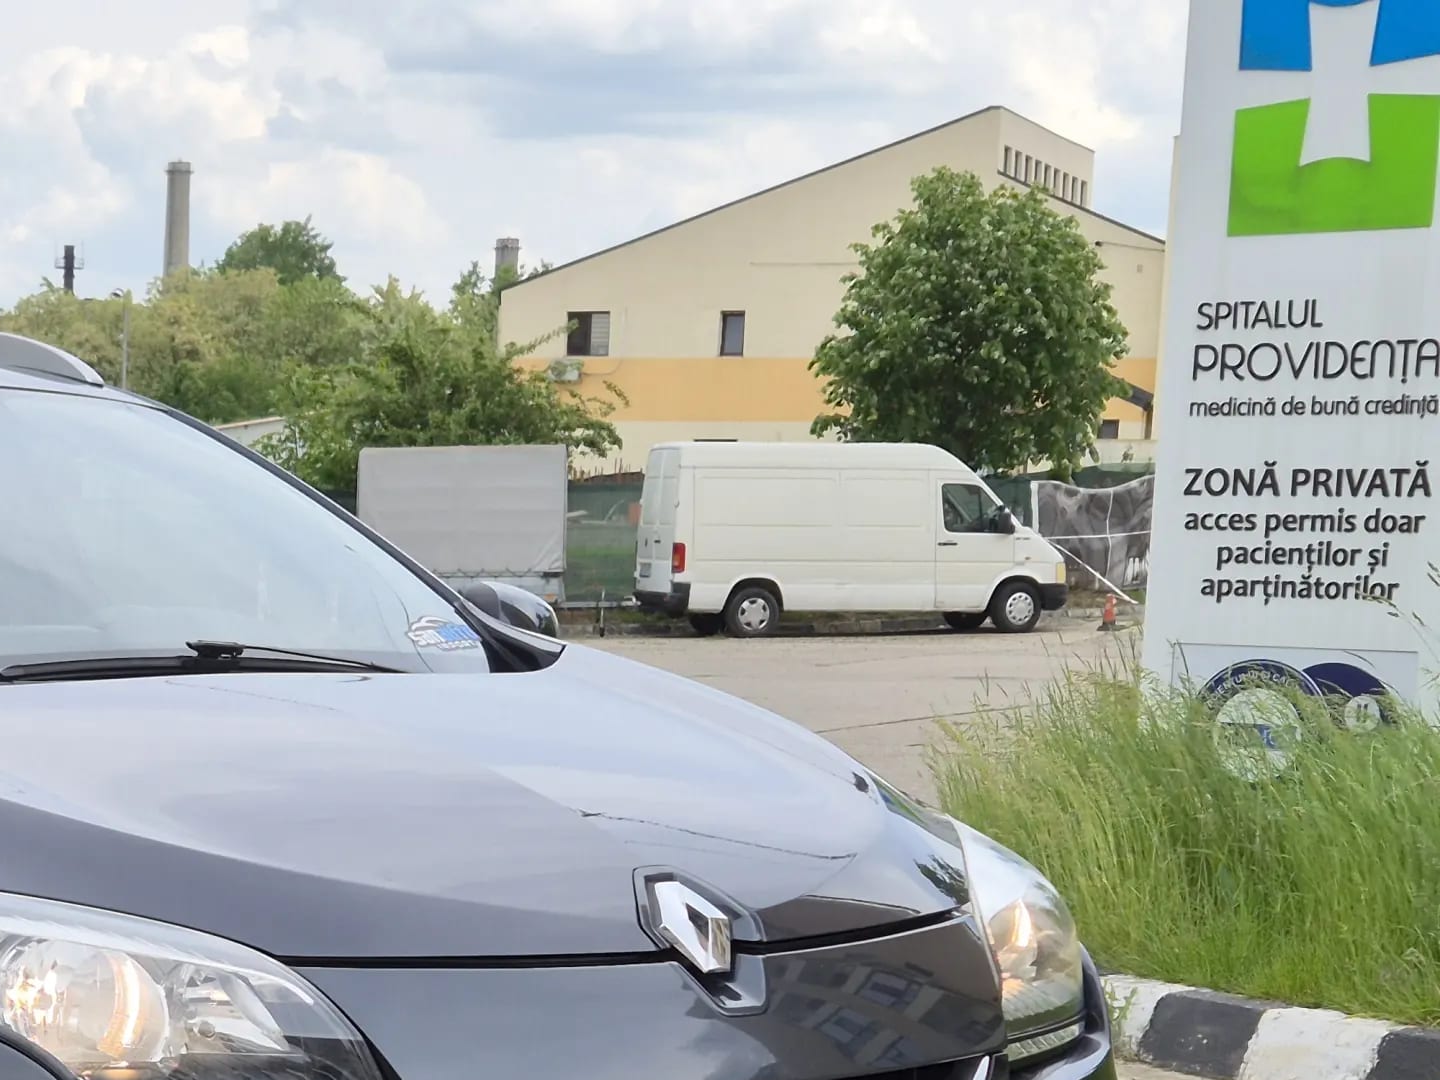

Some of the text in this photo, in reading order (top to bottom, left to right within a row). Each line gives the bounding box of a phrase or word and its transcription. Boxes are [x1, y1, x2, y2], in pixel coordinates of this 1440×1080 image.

[1196, 299, 1323, 330] SPITALUL
[1189, 396, 1276, 416] medicină
[1281, 396, 1306, 416] de
[1311, 396, 1359, 416] bună
[1183, 460, 1432, 498] ZONĂ PRIVATĂ
[1184, 508, 1426, 538] acces permis doar
[1216, 541, 1390, 573] pacienților și
[1200, 573, 1400, 606] aparținătorilor
